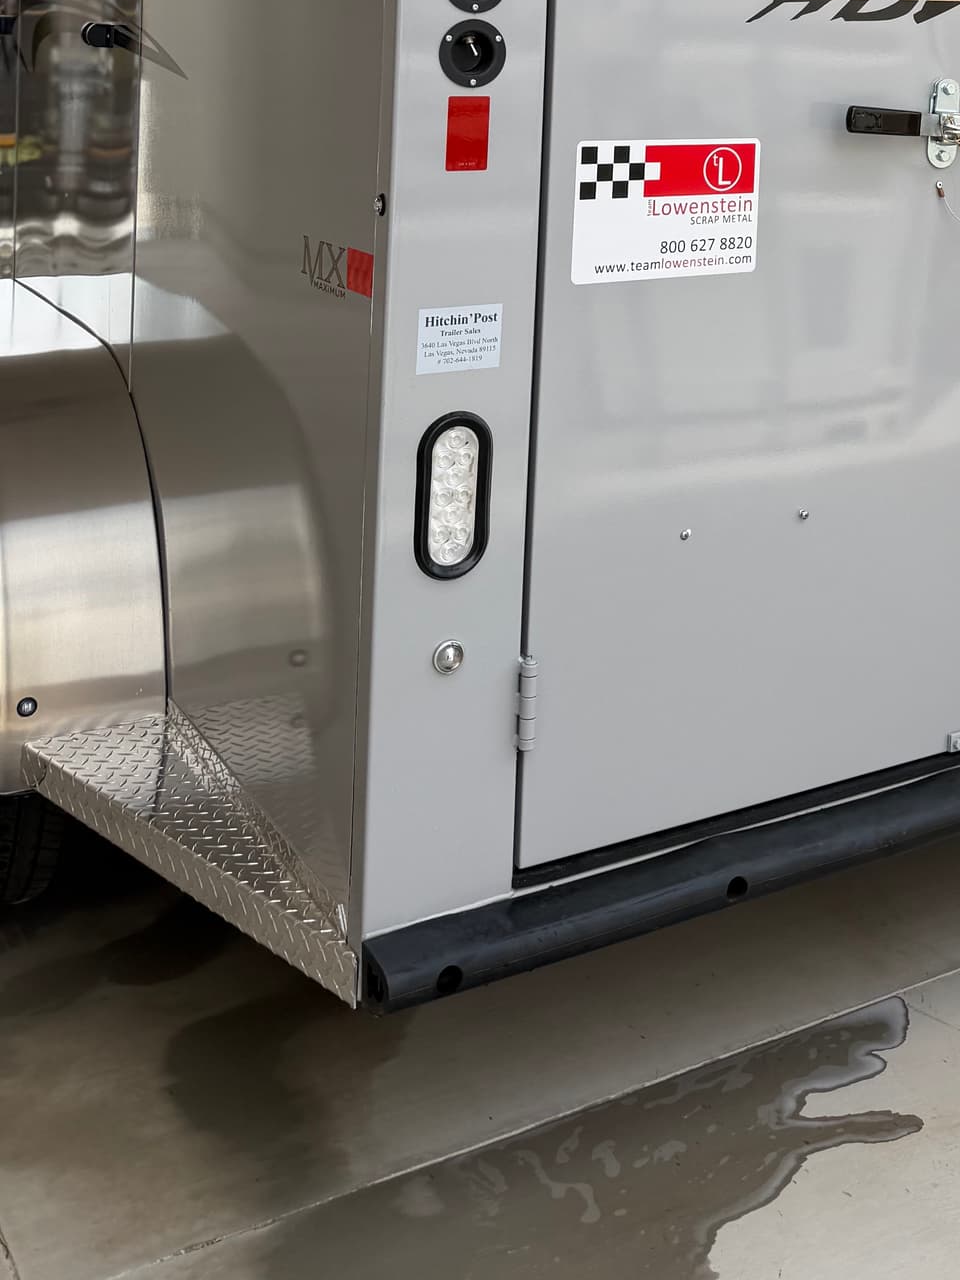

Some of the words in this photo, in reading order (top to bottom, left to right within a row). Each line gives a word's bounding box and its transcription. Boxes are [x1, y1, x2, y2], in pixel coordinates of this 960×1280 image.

[653, 196, 753, 216] Lowenstein
[690, 215, 720, 225] SCRAP
[722, 214, 753, 224] METAL
[660, 240, 686, 254] 800
[690, 238, 715, 252] 627
[719, 236, 753, 250] 8820
[301, 235, 346, 289] MX
[595, 255, 752, 274] www.teamlowenstein.com
[440, 329, 463, 337] Trailer
[464, 327, 481, 335] Sales
[448, 339, 466, 348] Vegas
[456, 347, 478, 355] Nevada
